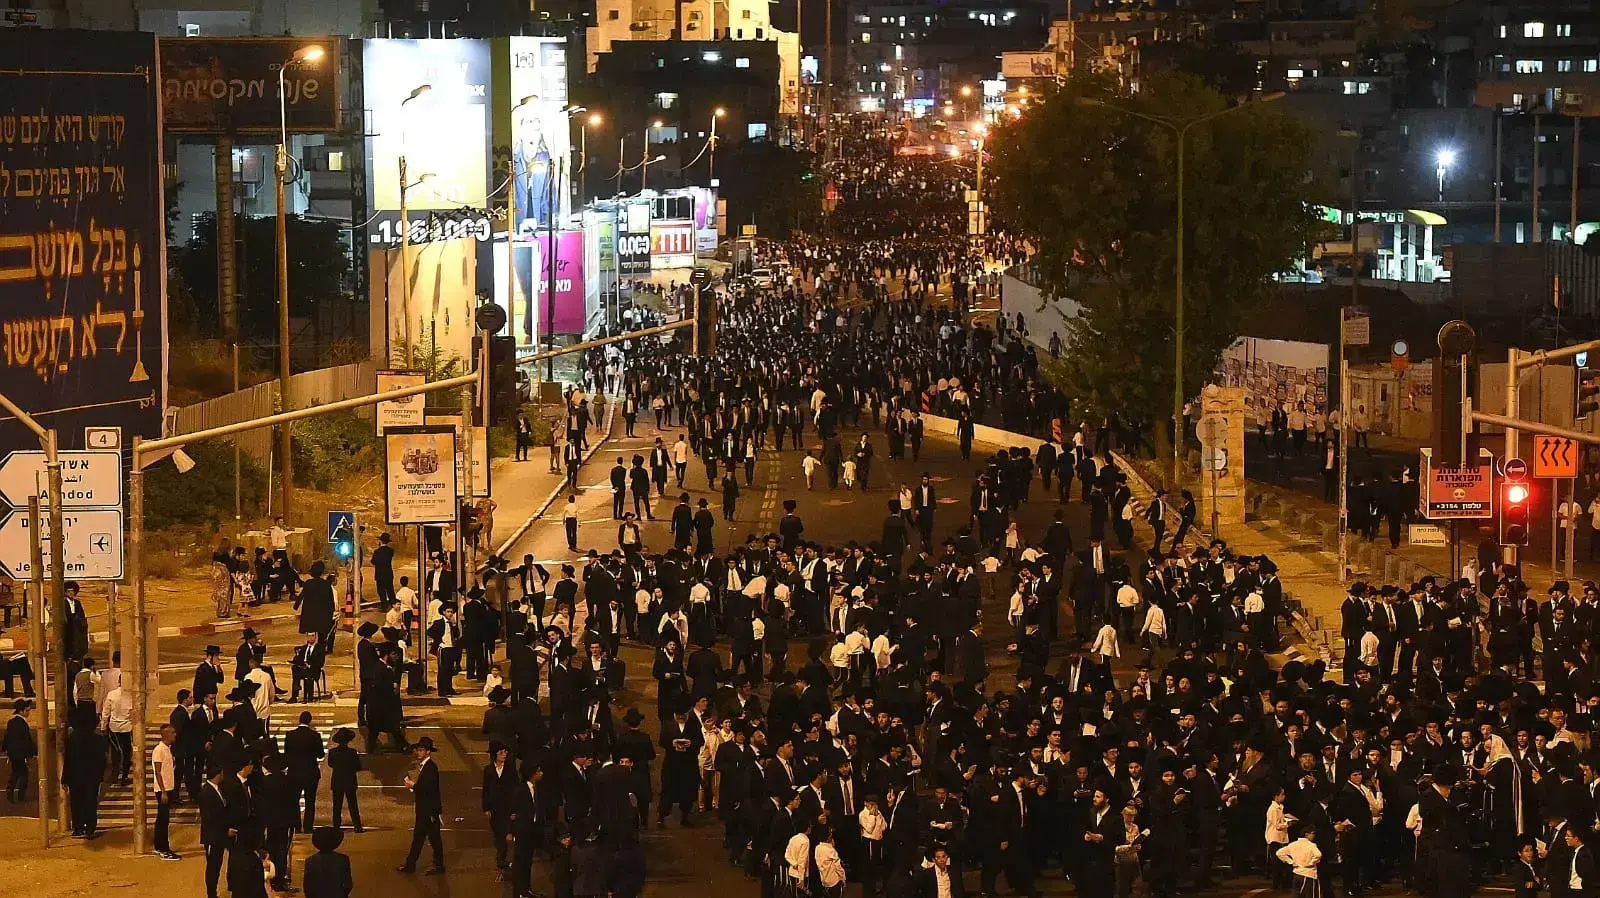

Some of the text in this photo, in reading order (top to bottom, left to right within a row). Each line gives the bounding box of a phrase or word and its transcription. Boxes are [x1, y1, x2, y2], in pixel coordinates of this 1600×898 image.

[276, 79, 319, 104] שנה
[99, 434, 107, 445] 4
[40, 490, 93, 500] Adod
[1462, 502, 1482, 510] טלפון
[15, 562, 85, 572] Jesem
